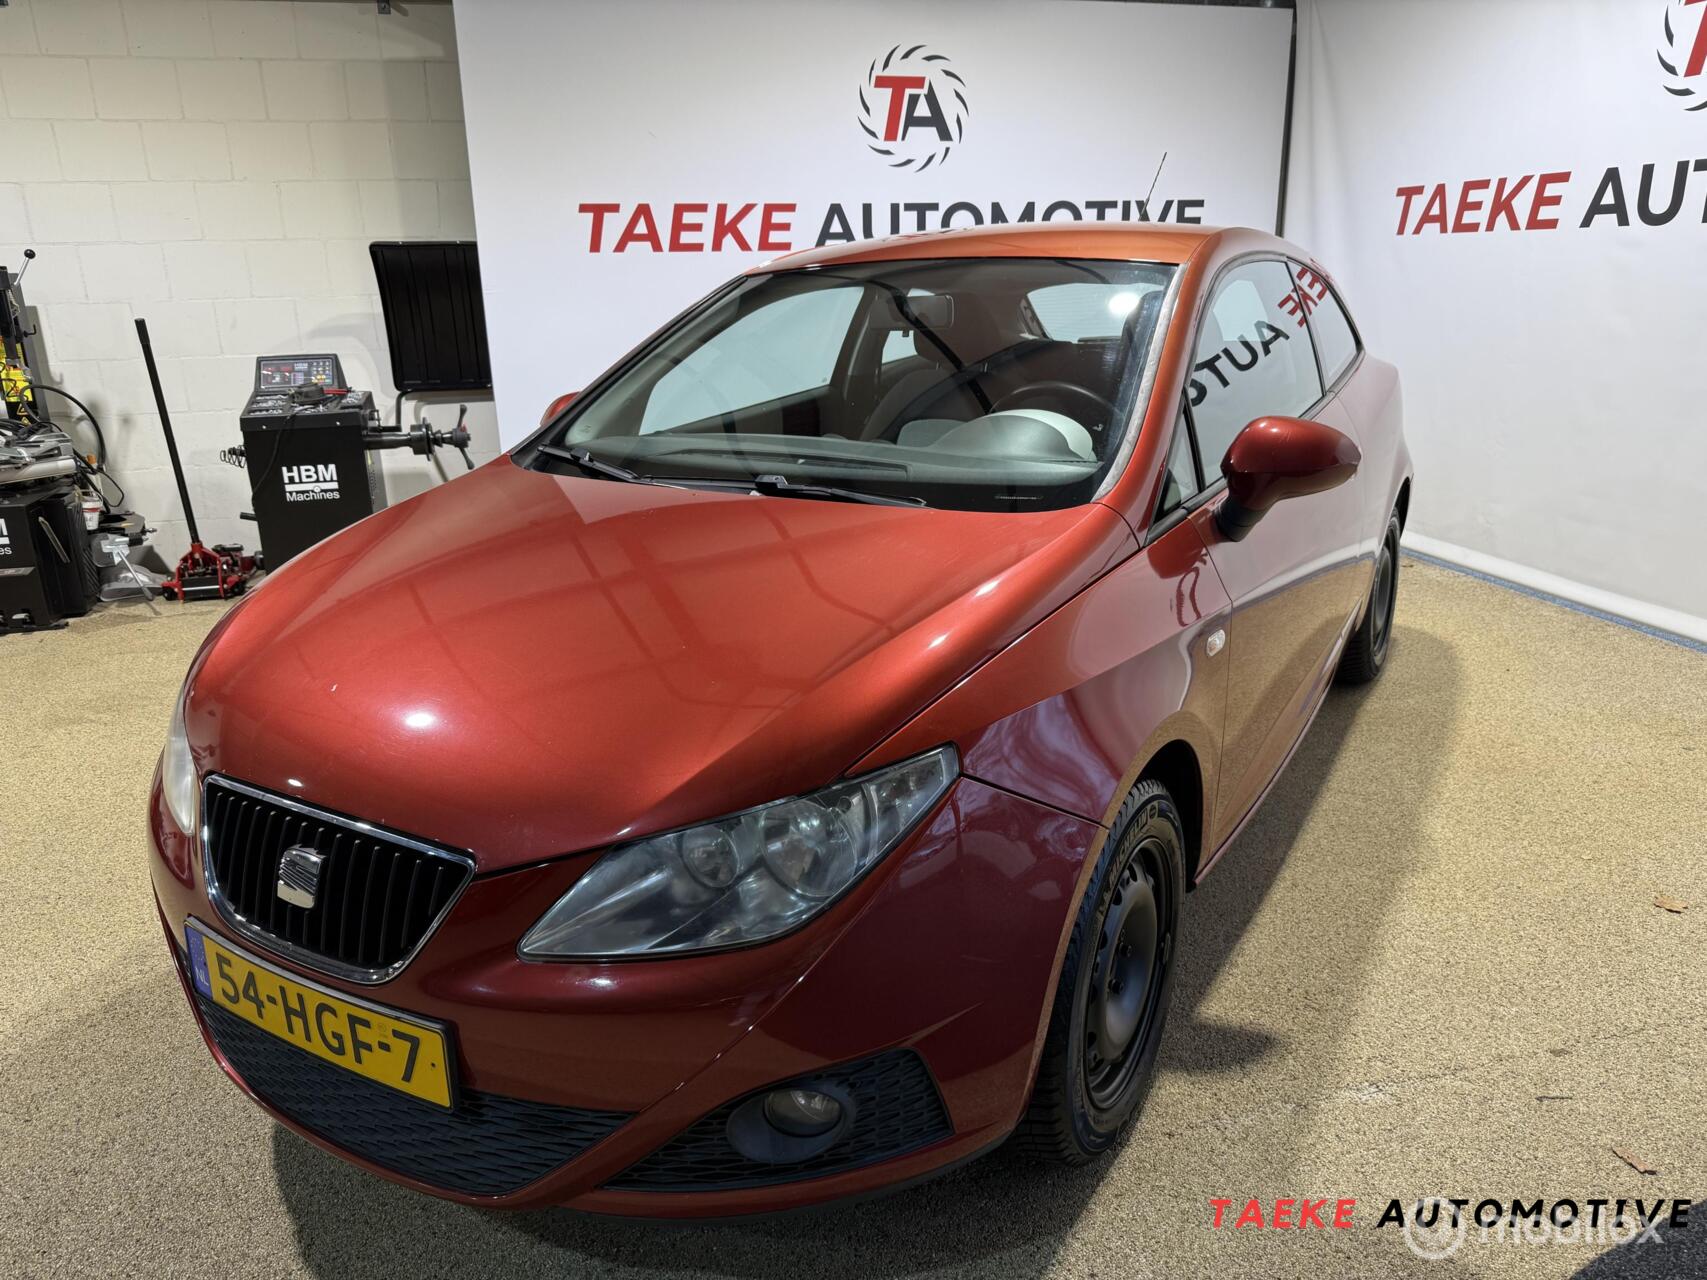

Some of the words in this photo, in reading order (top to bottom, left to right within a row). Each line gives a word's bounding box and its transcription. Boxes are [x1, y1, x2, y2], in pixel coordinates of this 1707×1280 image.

[873, 75, 953, 142] TA
[578, 203, 797, 253] TAEKE
[1395, 171, 1572, 236] TAEKE
[281, 463, 338, 484] HBM
[286, 490, 341, 502] Machines
[215, 951, 421, 1083] 54-HGF-7
